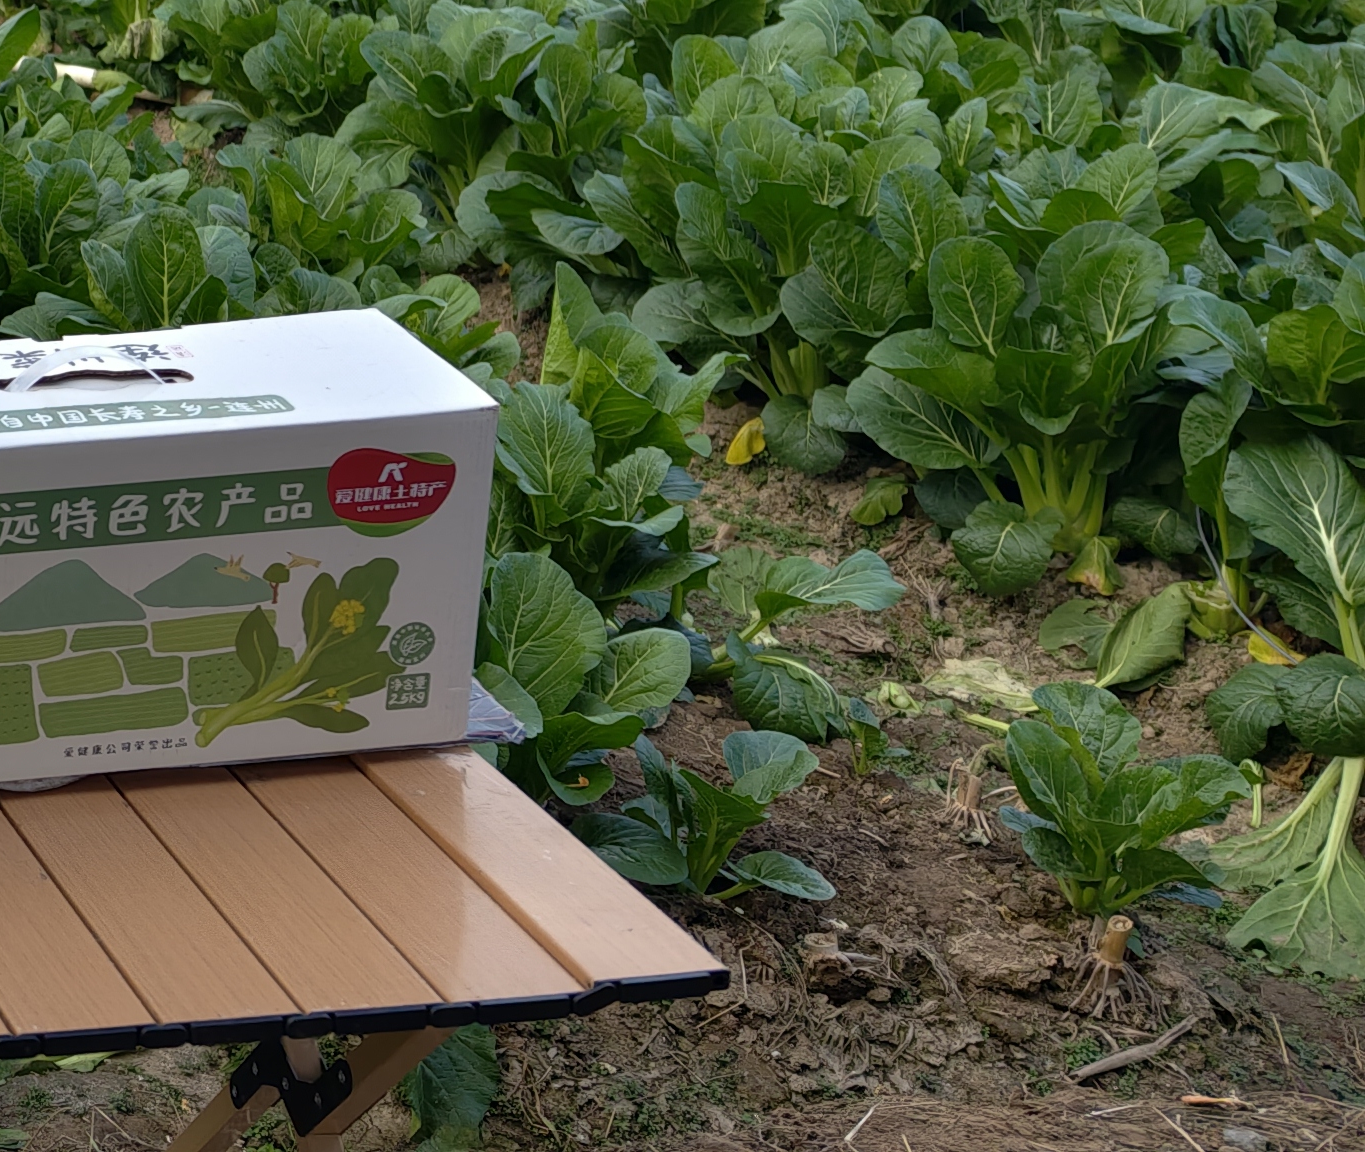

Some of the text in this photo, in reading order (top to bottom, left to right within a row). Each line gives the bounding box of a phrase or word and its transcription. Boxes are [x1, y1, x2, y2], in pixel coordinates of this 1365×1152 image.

[335, 481, 447, 504] 爱健康土特产
[383, 502, 419, 510] HEALTH
[390, 676, 427, 691] 净含量
